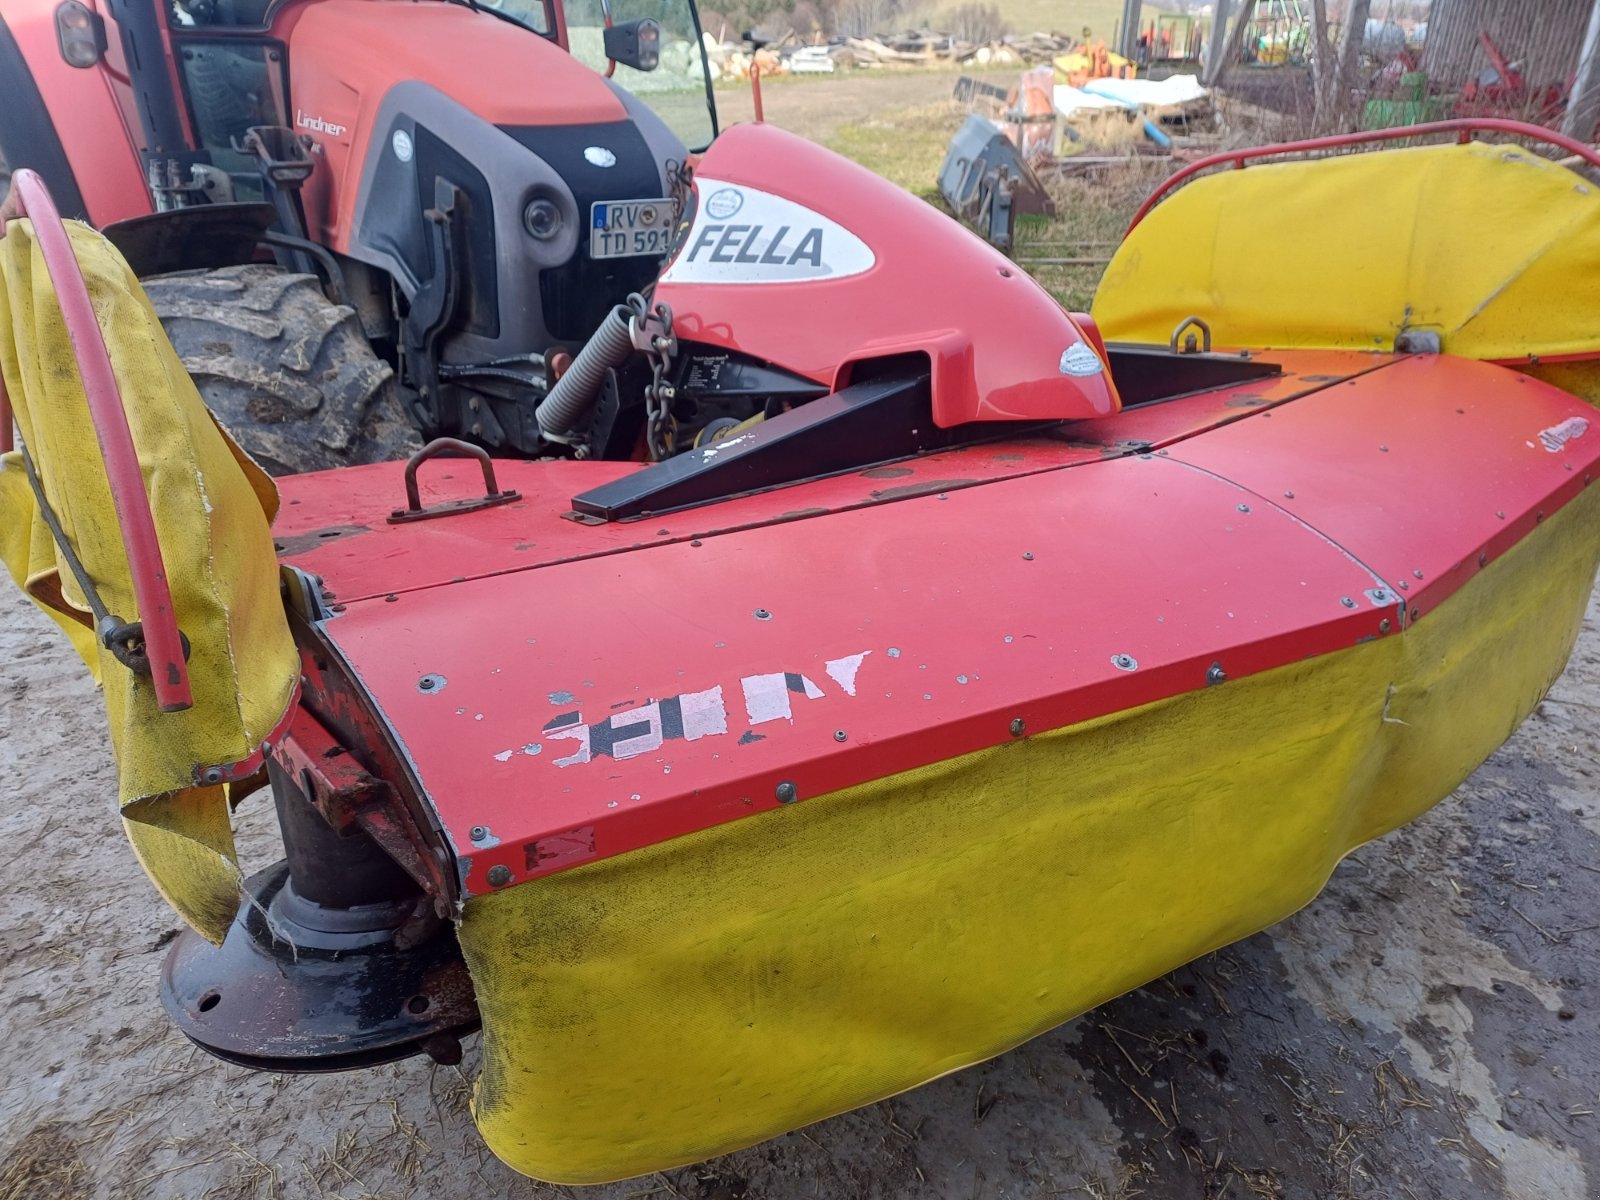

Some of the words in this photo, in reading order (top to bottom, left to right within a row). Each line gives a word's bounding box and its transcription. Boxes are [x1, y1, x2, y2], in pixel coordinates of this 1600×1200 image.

[297, 109, 347, 137] Lindner
[611, 206, 638, 228] RV
[600, 233, 626, 255] TD
[687, 224, 823, 267] FELLA
